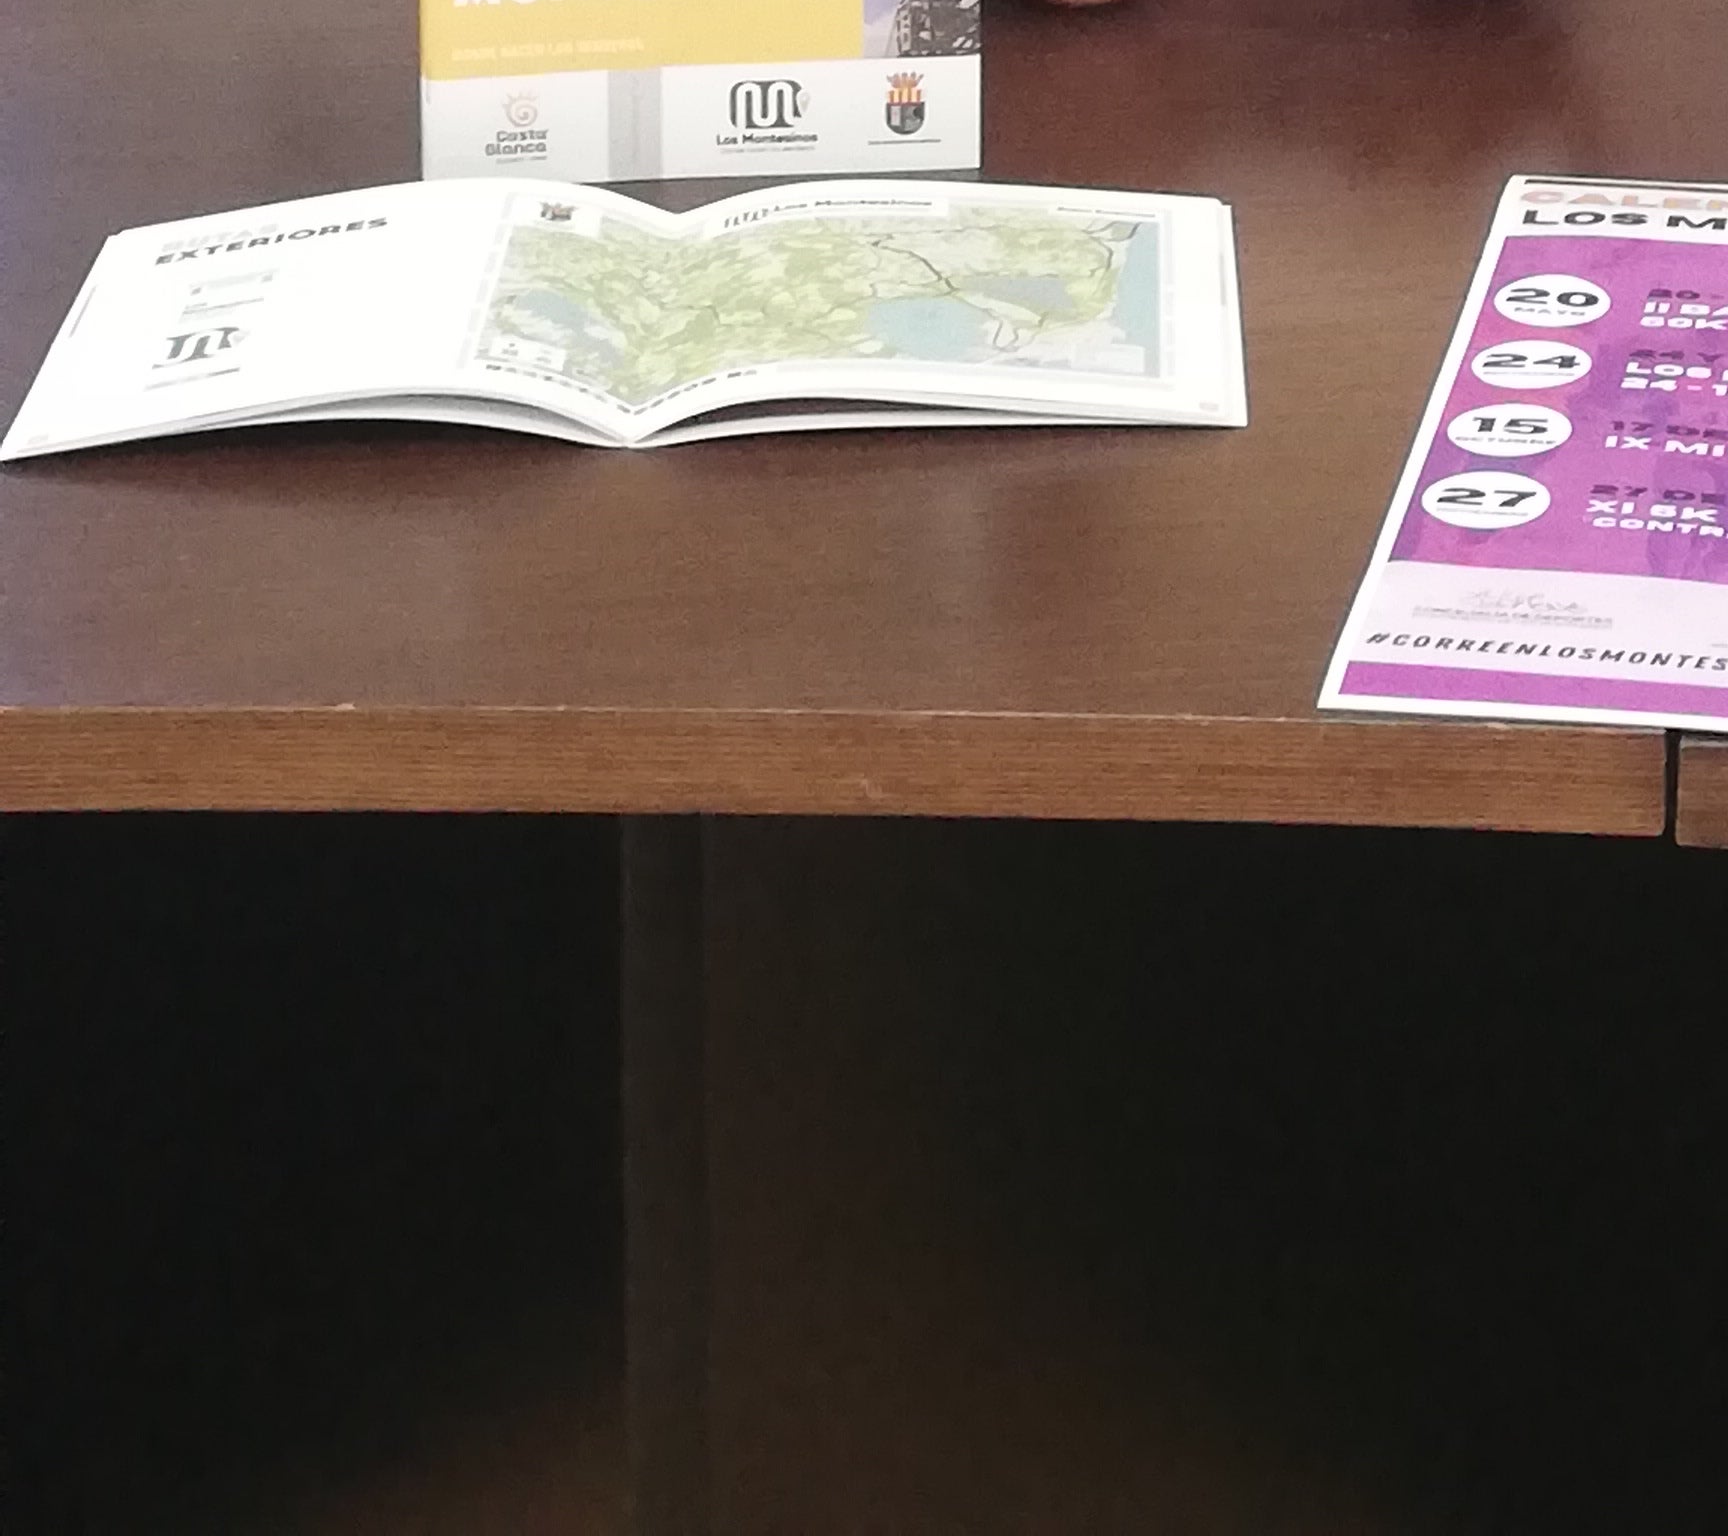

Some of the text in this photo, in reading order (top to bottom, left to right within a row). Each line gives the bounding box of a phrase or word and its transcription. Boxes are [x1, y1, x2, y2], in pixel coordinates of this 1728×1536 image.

[716, 132, 818, 146] Los Montesinos
[1522, 210, 1650, 227] LOS
[155, 217, 388, 266] EXTERIORES
[1506, 287, 1599, 308] 20
[1482, 352, 1581, 370] 24
[1625, 361, 1713, 379] LOS
[1472, 416, 1550, 434] 15
[1604, 435, 1654, 451] IX
[1436, 486, 1538, 508] 27
[1586, 499, 1636, 515] XI
